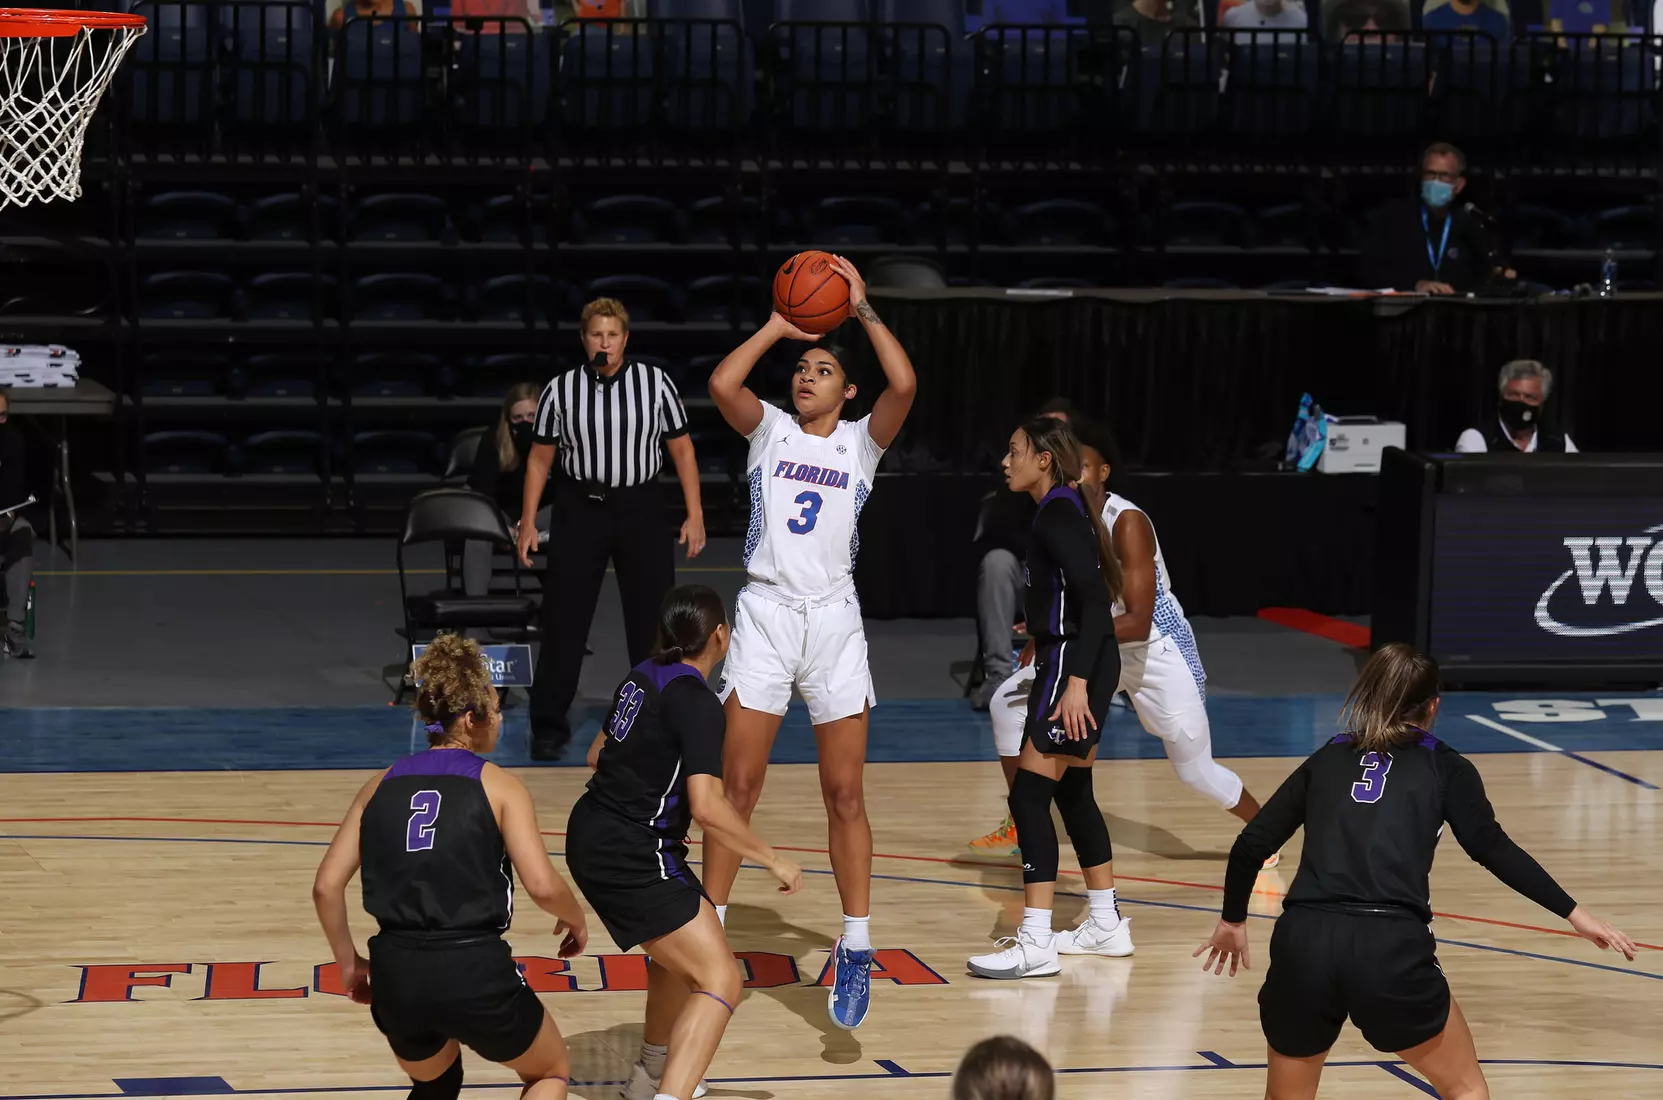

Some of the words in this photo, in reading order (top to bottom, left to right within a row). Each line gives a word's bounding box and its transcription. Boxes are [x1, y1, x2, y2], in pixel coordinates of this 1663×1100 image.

[772, 459, 850, 490] FLORIDA
[786, 490, 824, 535] 3
[609, 680, 645, 742] 33
[1350, 751, 1394, 804] 3
[406, 789, 442, 852] 2
[62, 948, 950, 1004] FLRIDA
